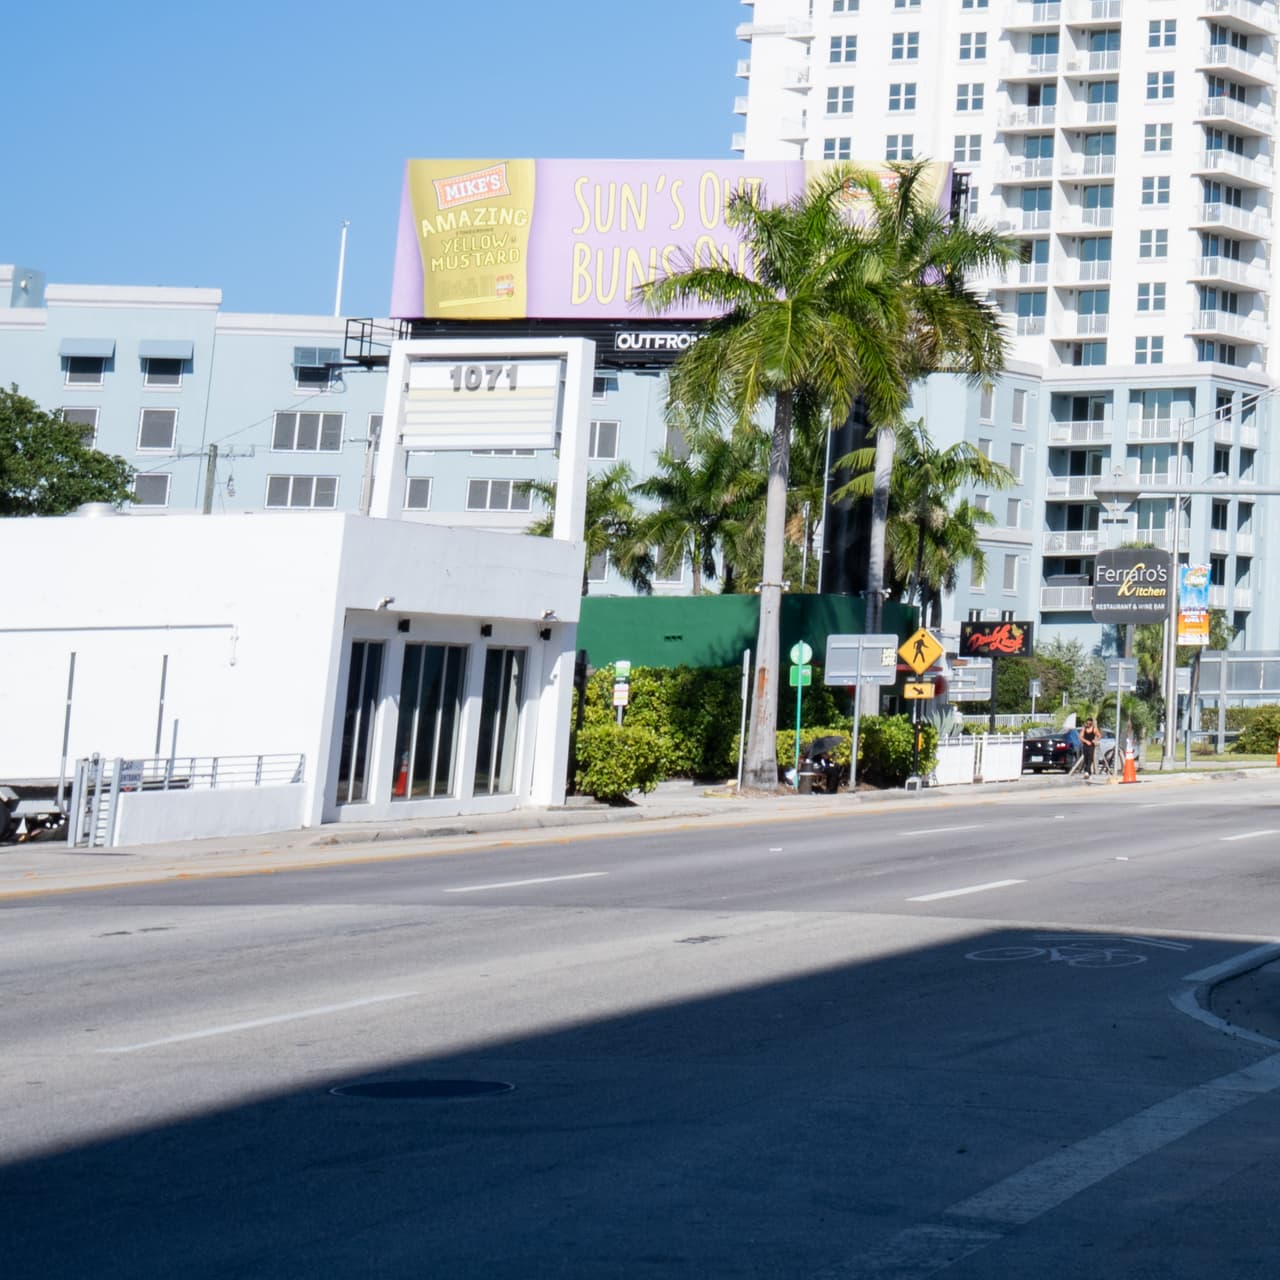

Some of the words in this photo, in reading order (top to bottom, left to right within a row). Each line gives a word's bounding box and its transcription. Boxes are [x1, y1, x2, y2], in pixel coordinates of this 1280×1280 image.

[444, 173, 502, 201] MIKE'S
[421, 207, 528, 238] AMAZING
[441, 232, 510, 254] YELLOW
[431, 247, 521, 273] MUSTARD
[450, 364, 518, 392] 1071
[1096, 564, 1167, 582] Ferraro's
